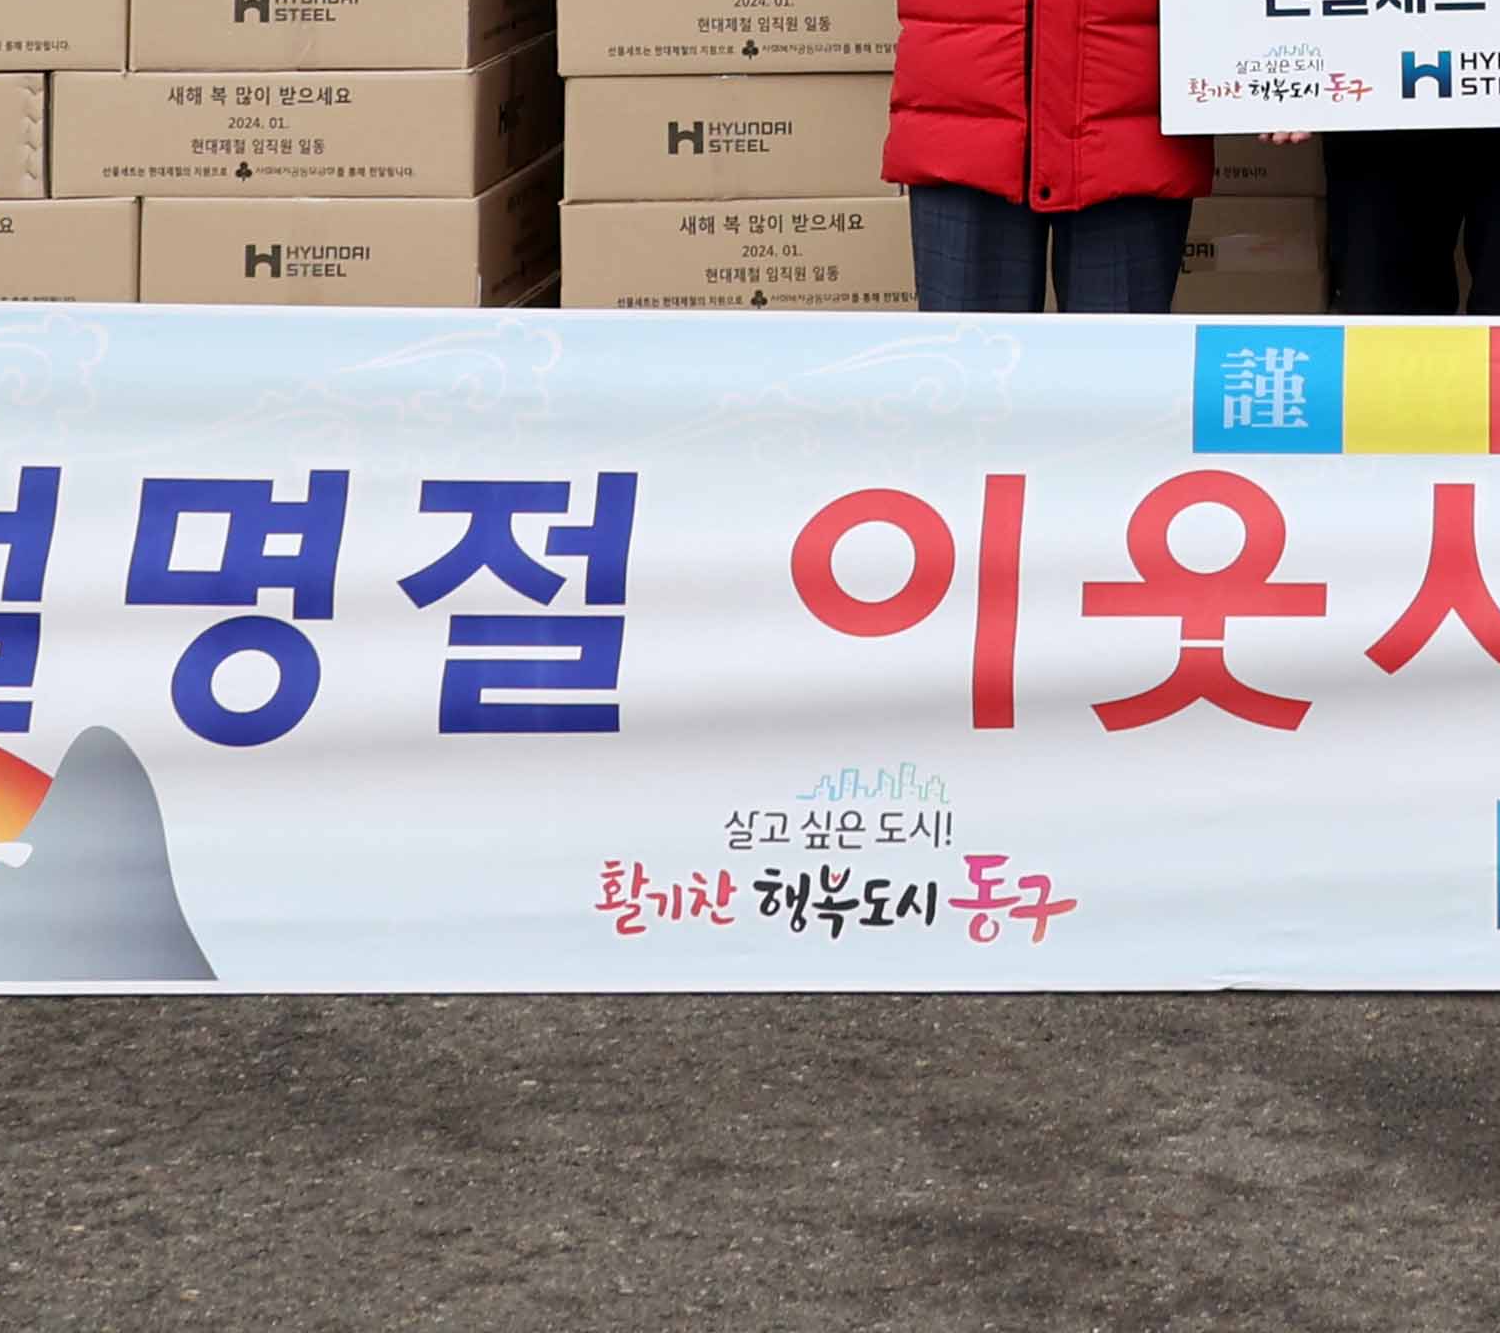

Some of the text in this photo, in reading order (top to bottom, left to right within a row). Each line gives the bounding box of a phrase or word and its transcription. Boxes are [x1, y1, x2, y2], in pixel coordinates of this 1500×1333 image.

[275, 8, 335, 21] STEEL
[1187, 71, 1372, 103] 활기찬 행복도시 동구
[726, 811, 951, 849] 살고 싶은 도시!
[596, 856, 1076, 941] 활기찬 행복도시 동구
